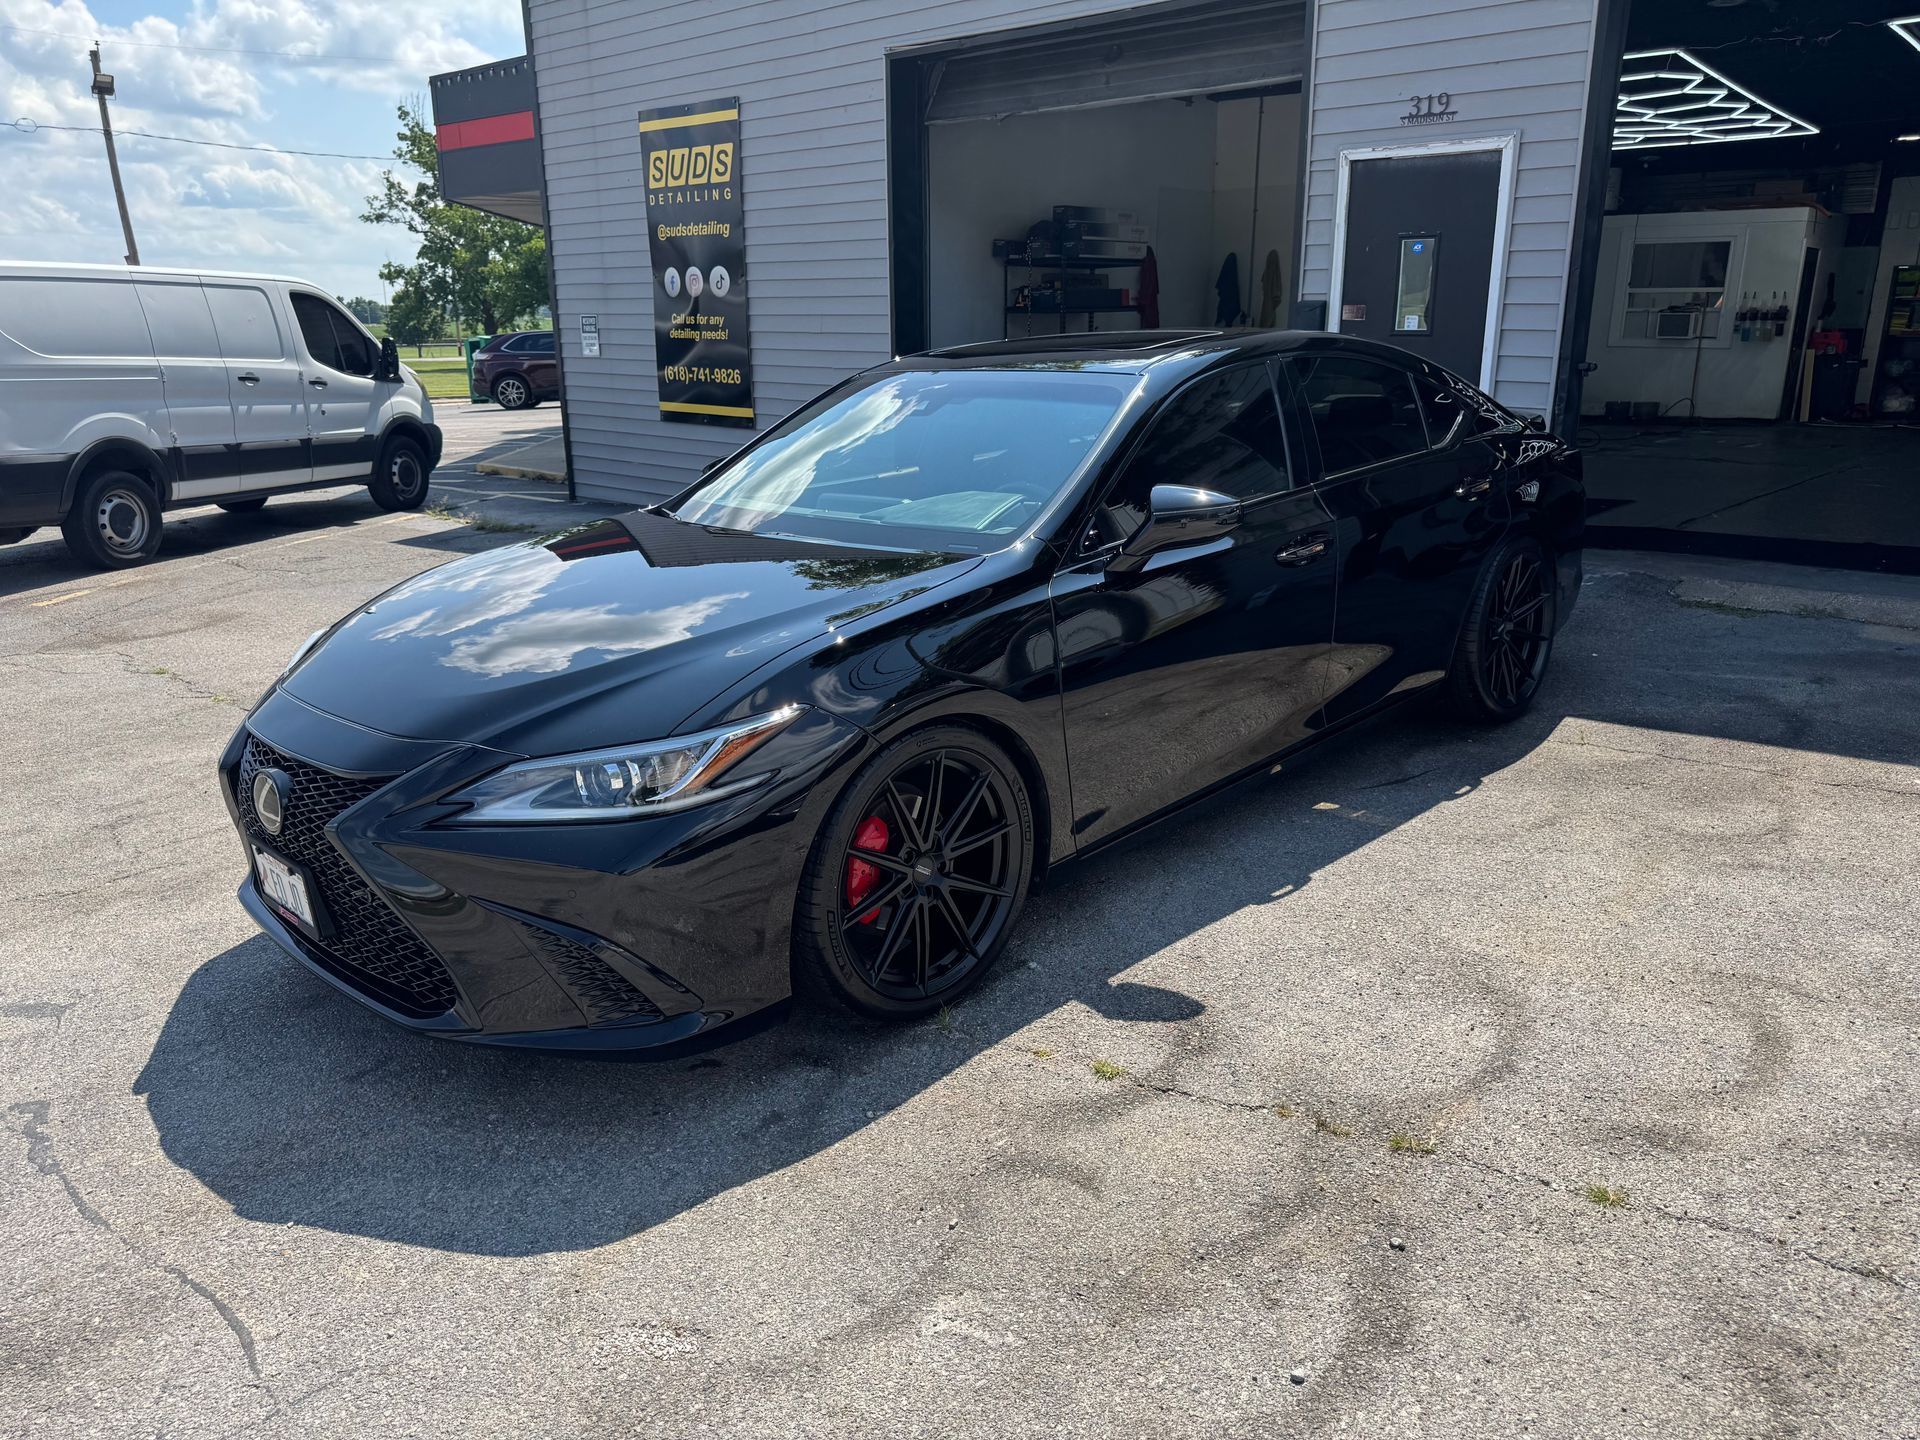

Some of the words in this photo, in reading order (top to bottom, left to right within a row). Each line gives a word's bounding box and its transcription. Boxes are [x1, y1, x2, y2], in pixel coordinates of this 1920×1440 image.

[1408, 92, 1450, 118] 319
[1407, 113, 1445, 126] MADISON
[651, 149, 729, 183] SUDS
[649, 187, 732, 206] DETAILING
[657, 220, 731, 241] @sudsdetailing
[671, 313, 685, 325] Call
[685, 315, 695, 325] us
[696, 313, 708, 325] for
[709, 315, 725, 328] any
[669, 327, 700, 342] detailing
[701, 328, 729, 340] needs!
[664, 365, 742, 385] (618)-741-9826
